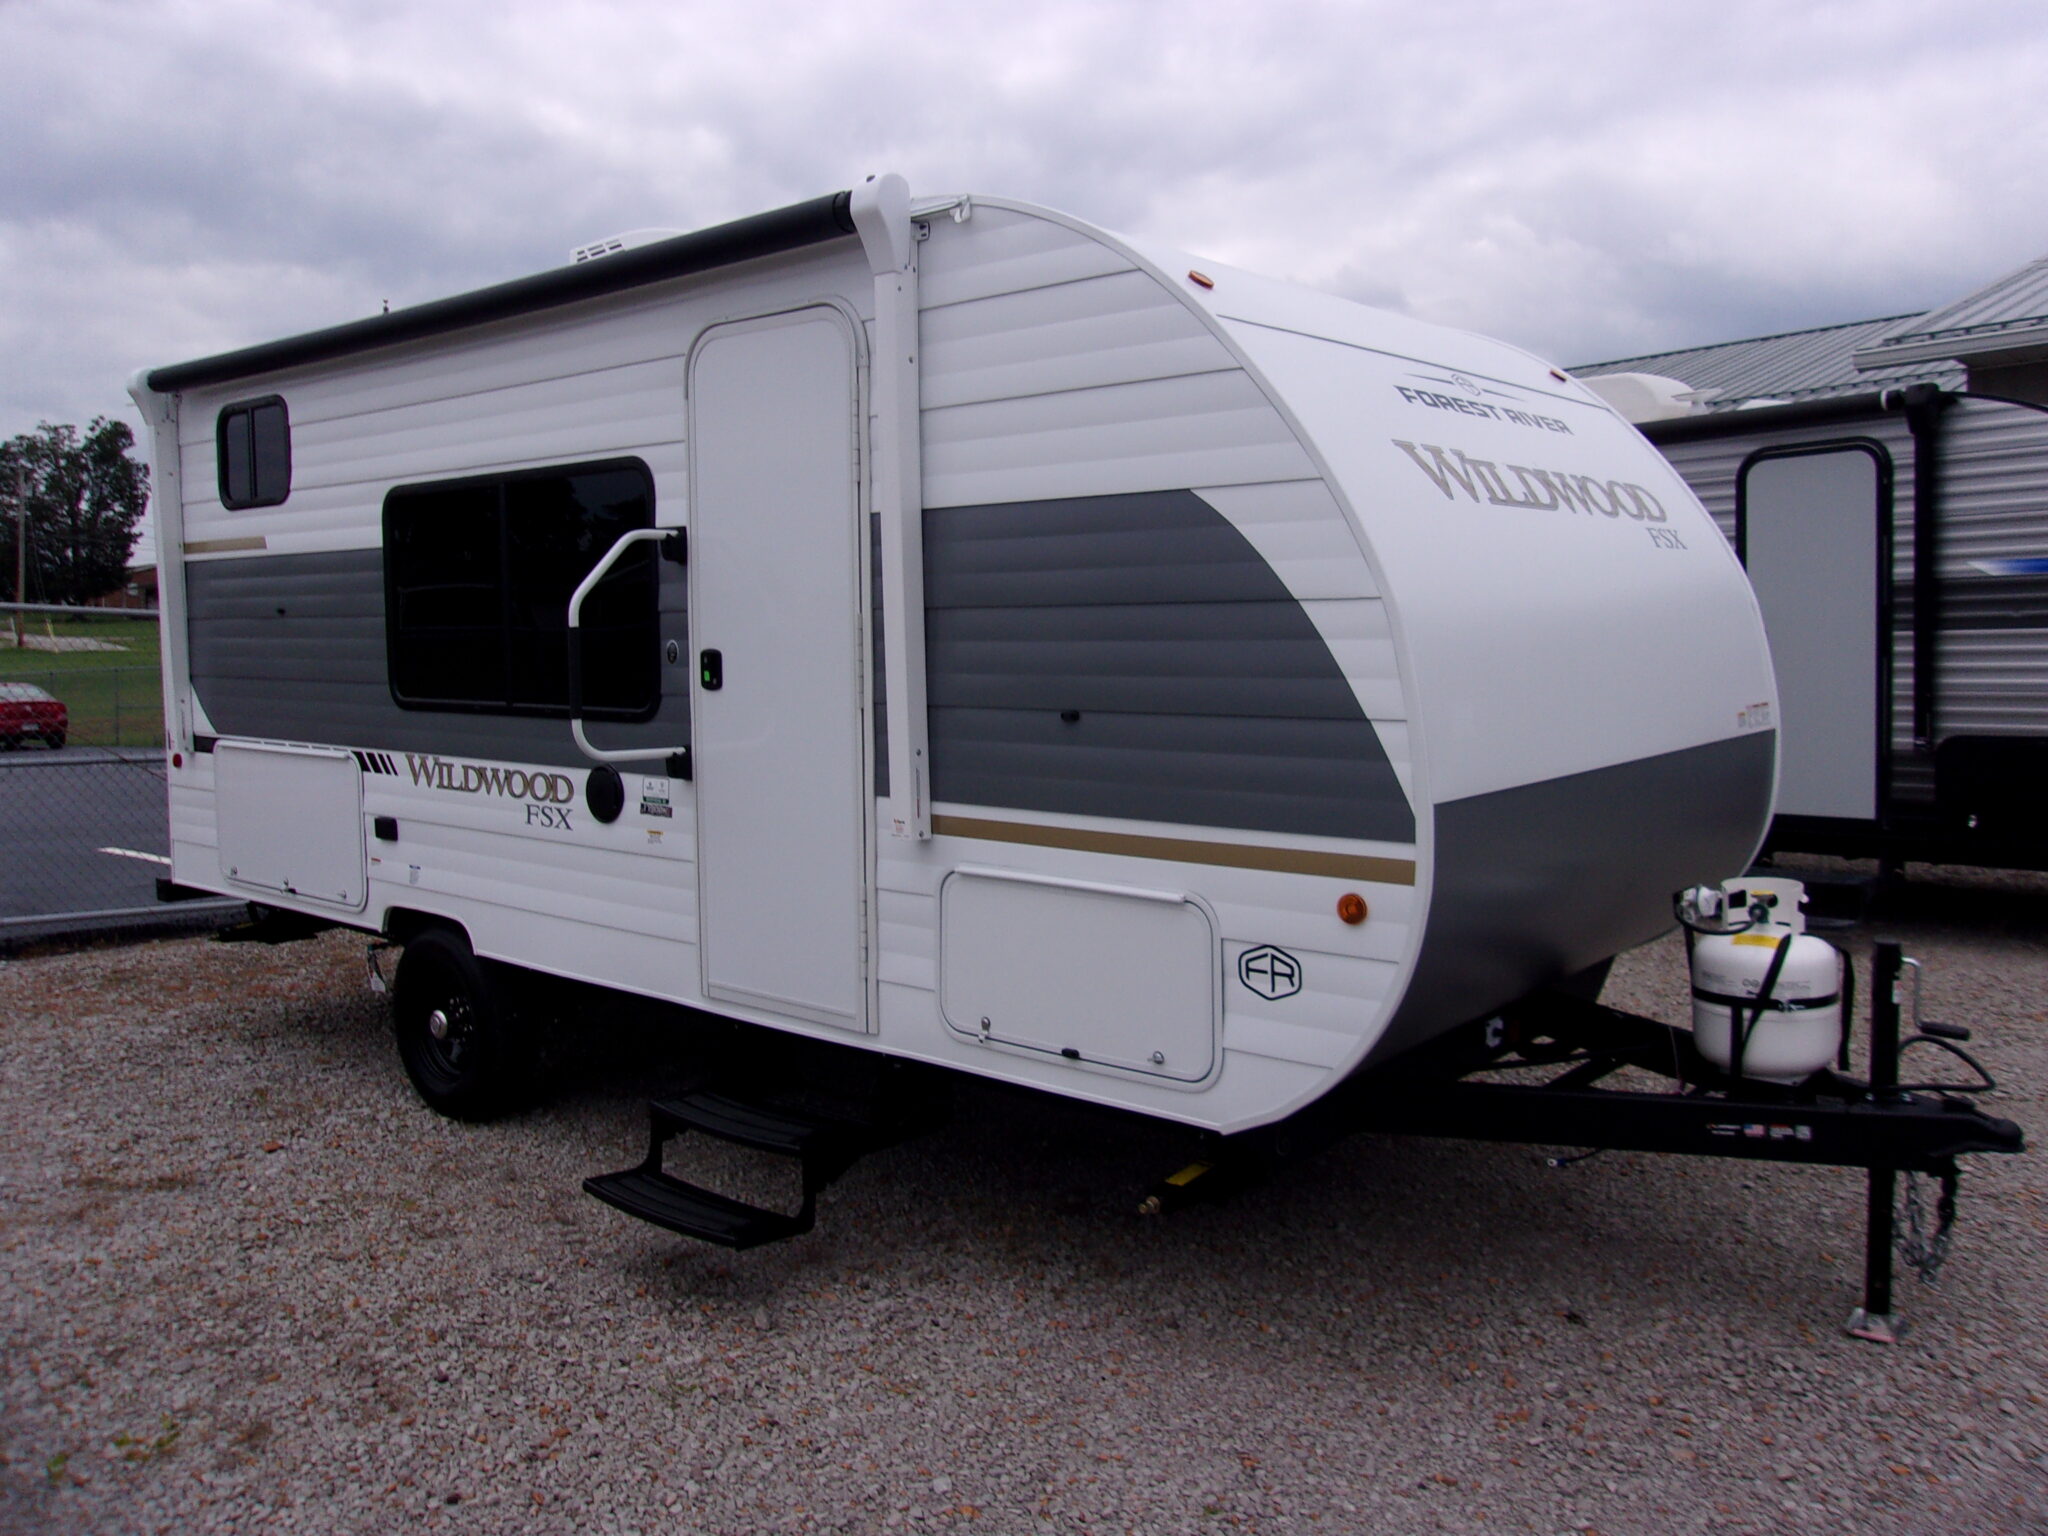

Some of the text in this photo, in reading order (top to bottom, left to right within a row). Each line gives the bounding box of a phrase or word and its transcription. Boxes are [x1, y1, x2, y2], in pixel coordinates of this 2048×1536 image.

[1393, 385, 1574, 435] FOREST RIVER
[1391, 439, 1667, 523] WILDWOOD
[1646, 527, 1688, 550] FSX
[405, 752, 575, 804] WILDWOOD
[525, 804, 574, 831] FSX
[1245, 952, 1295, 993] FR
